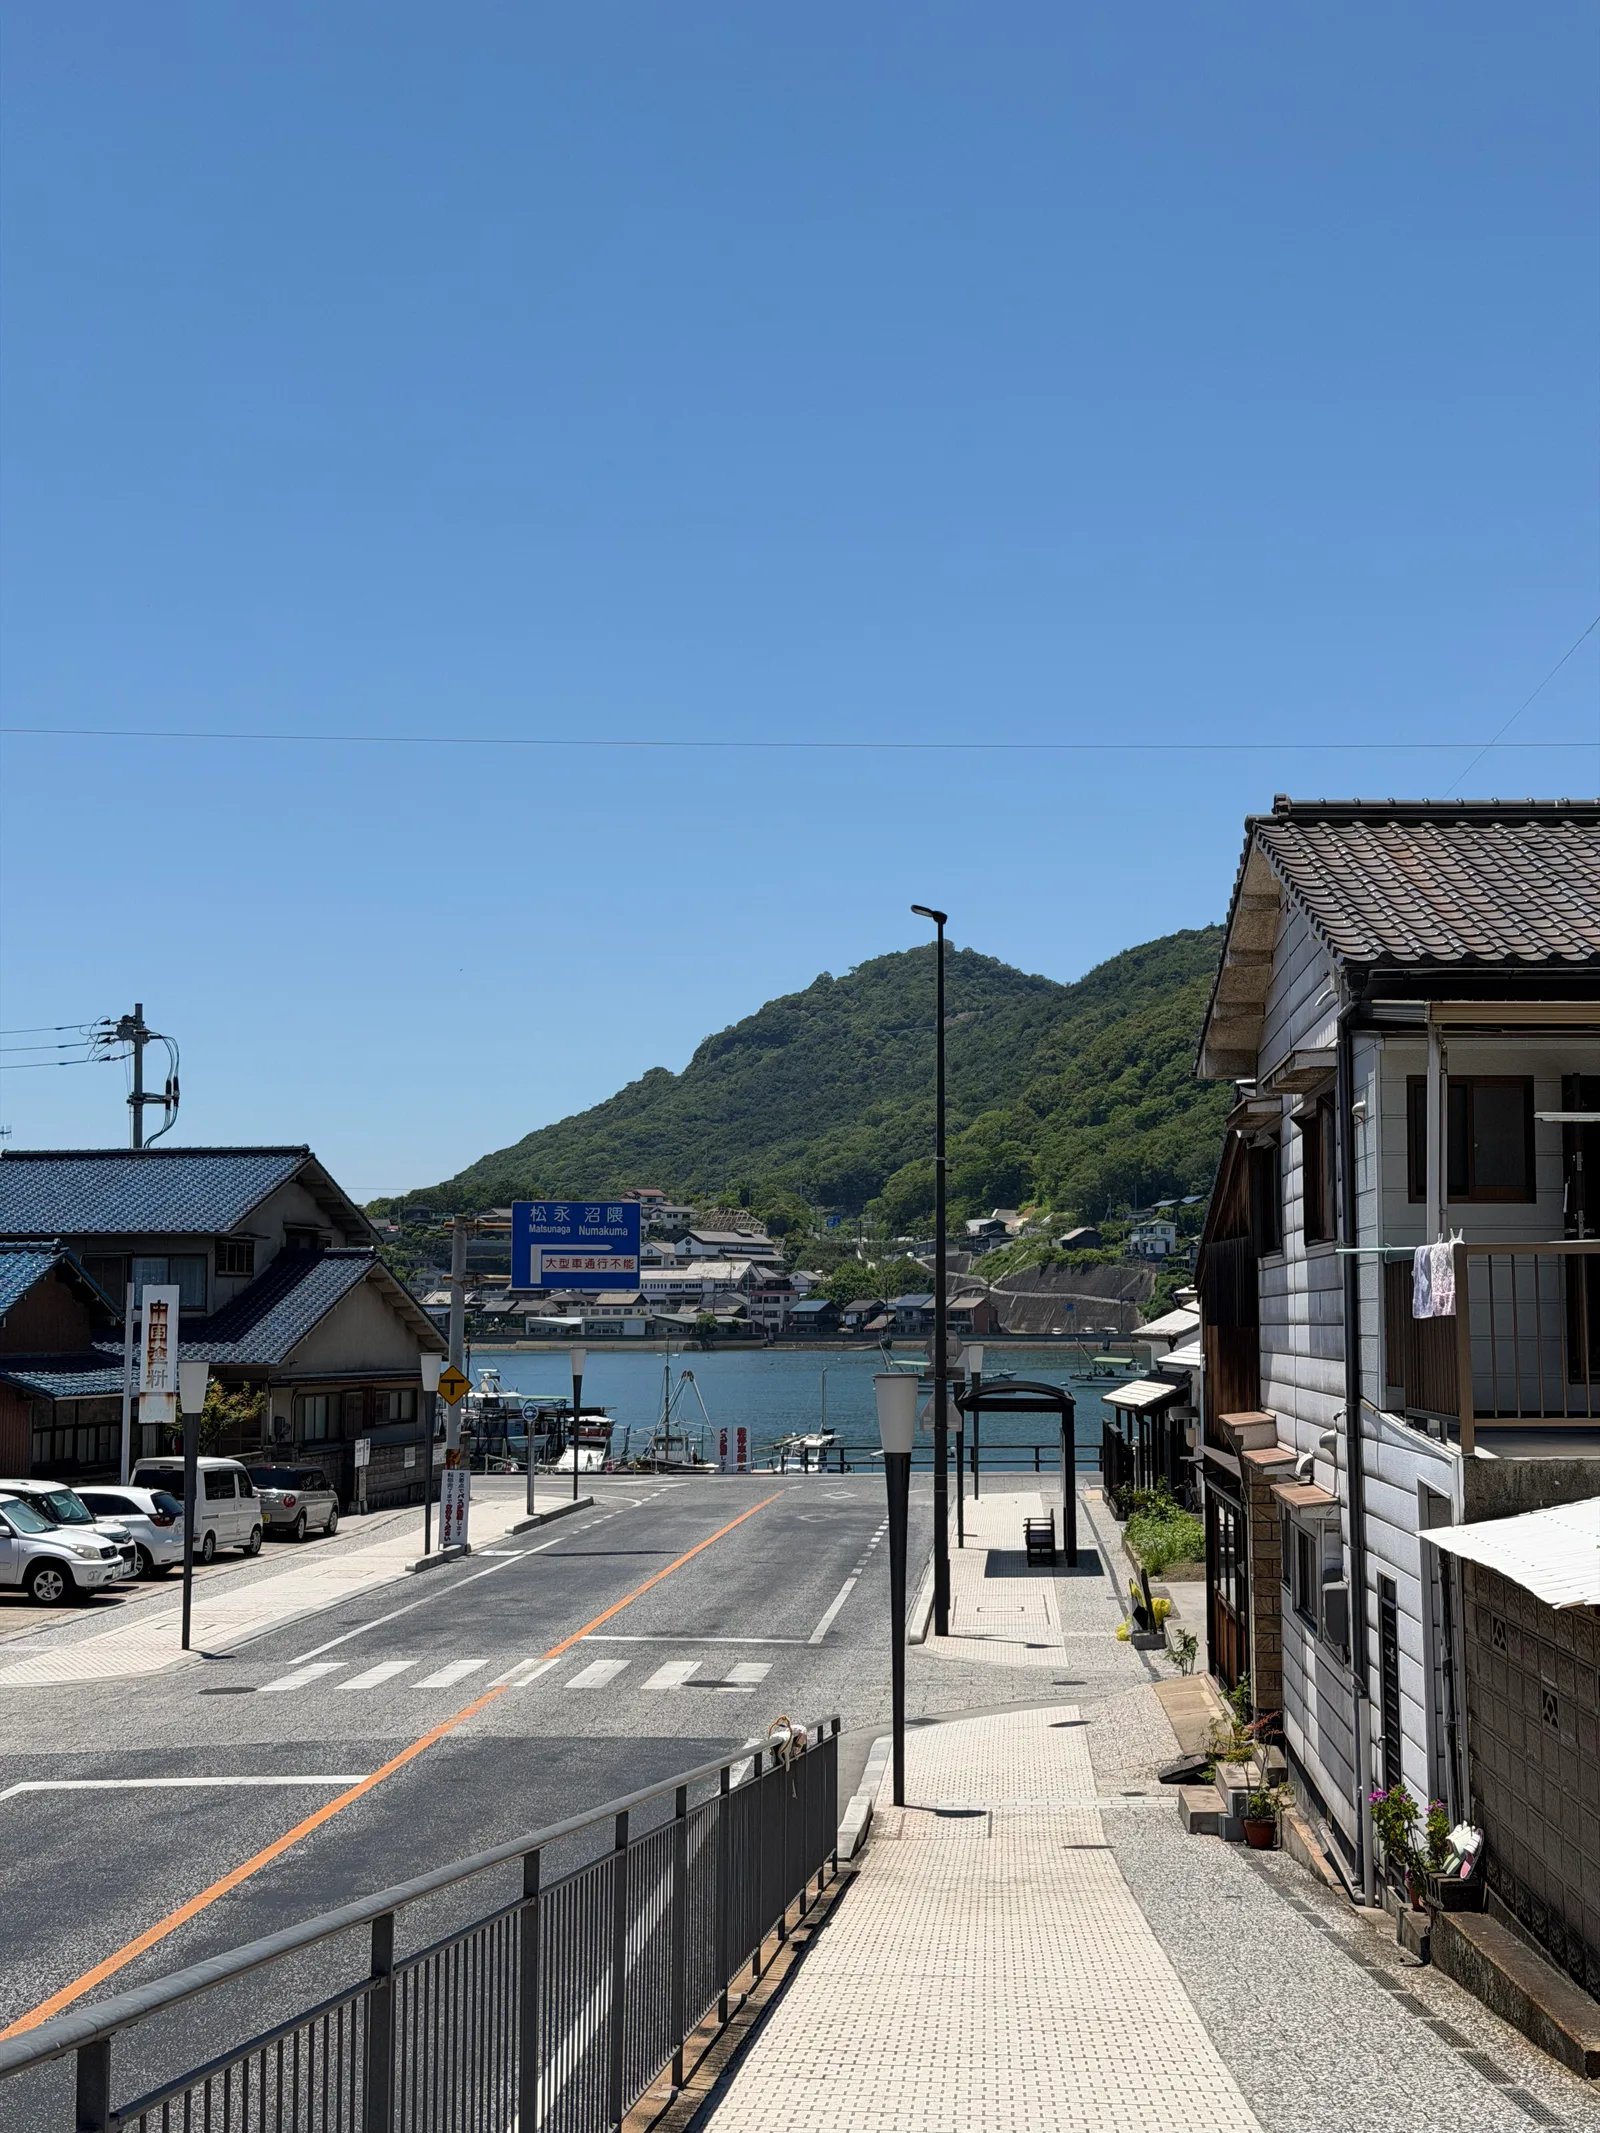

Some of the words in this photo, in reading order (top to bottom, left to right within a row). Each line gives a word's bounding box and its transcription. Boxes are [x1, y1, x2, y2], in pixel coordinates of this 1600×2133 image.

[529, 1205, 571, 1223] 松永
[584, 1206, 624, 1223] 沼隈
[528, 1223, 571, 1236] Matsunaga
[578, 1225, 628, 1236] Numakuma
[545, 1257, 635, 1270] 大型車通行不能
